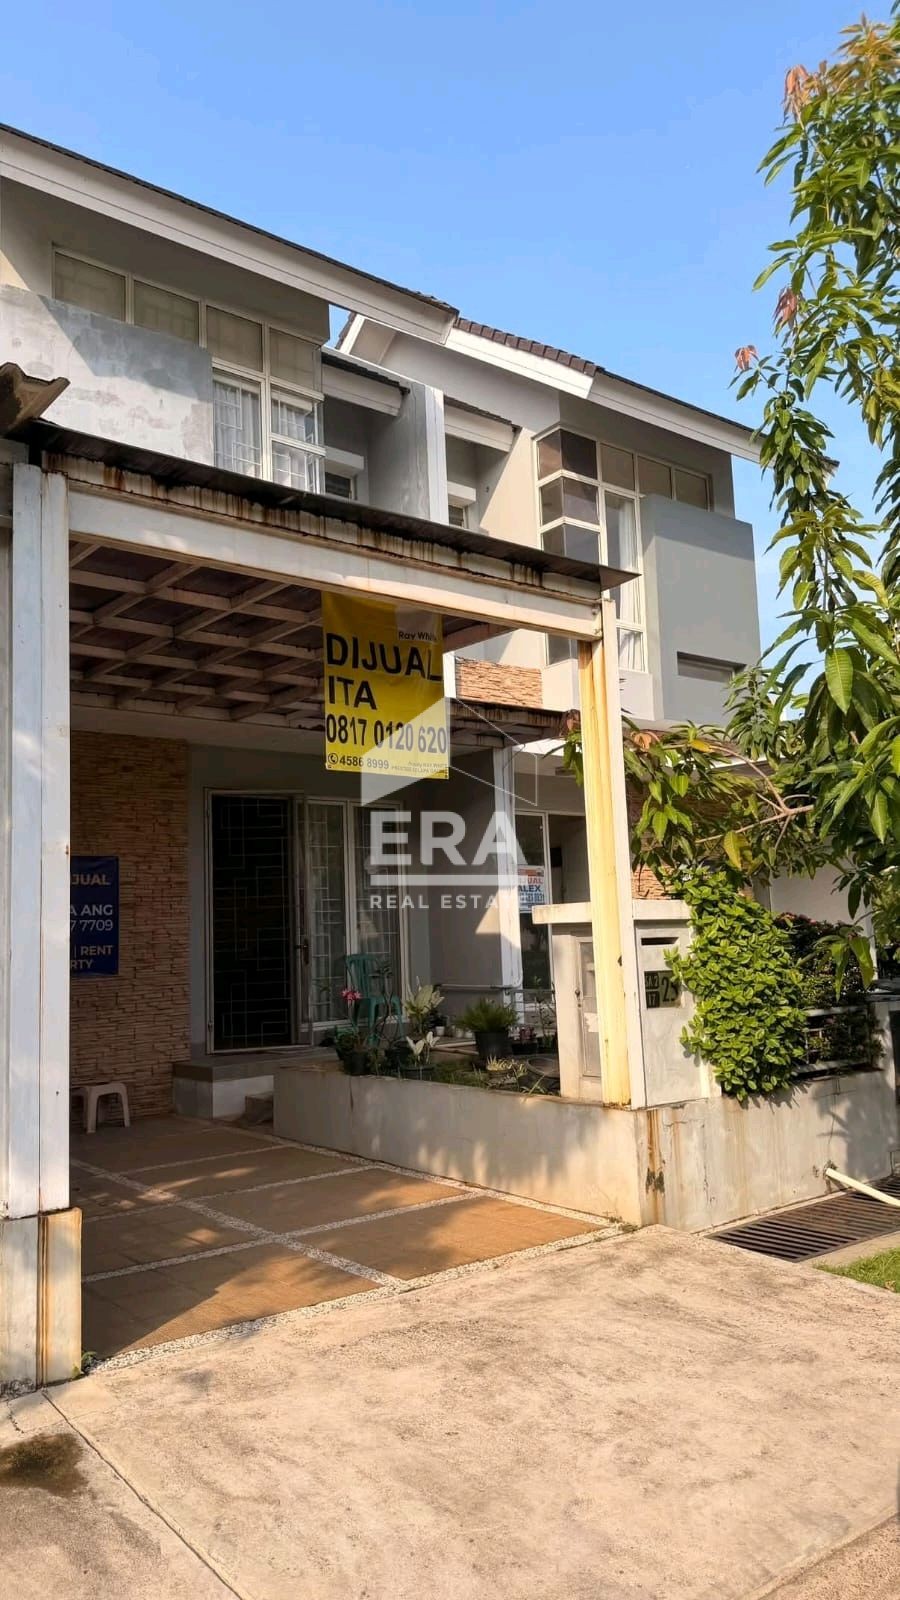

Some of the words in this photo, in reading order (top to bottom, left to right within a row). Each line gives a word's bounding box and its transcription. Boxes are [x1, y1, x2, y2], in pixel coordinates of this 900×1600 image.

[398, 631, 416, 641] Ray
[325, 632, 443, 681] DIJUAL
[328, 675, 378, 710] ITA
[326, 713, 367, 746] 0817
[374, 720, 413, 752] 0120
[418, 726, 447, 754] 620
[340, 755, 364, 767] 4586
[367, 758, 389, 770] 8999
[71, 873, 111, 886] JUAL
[80, 904, 113, 917] ANG
[80, 919, 114, 932] 7709
[81, 945, 113, 957] RENT
